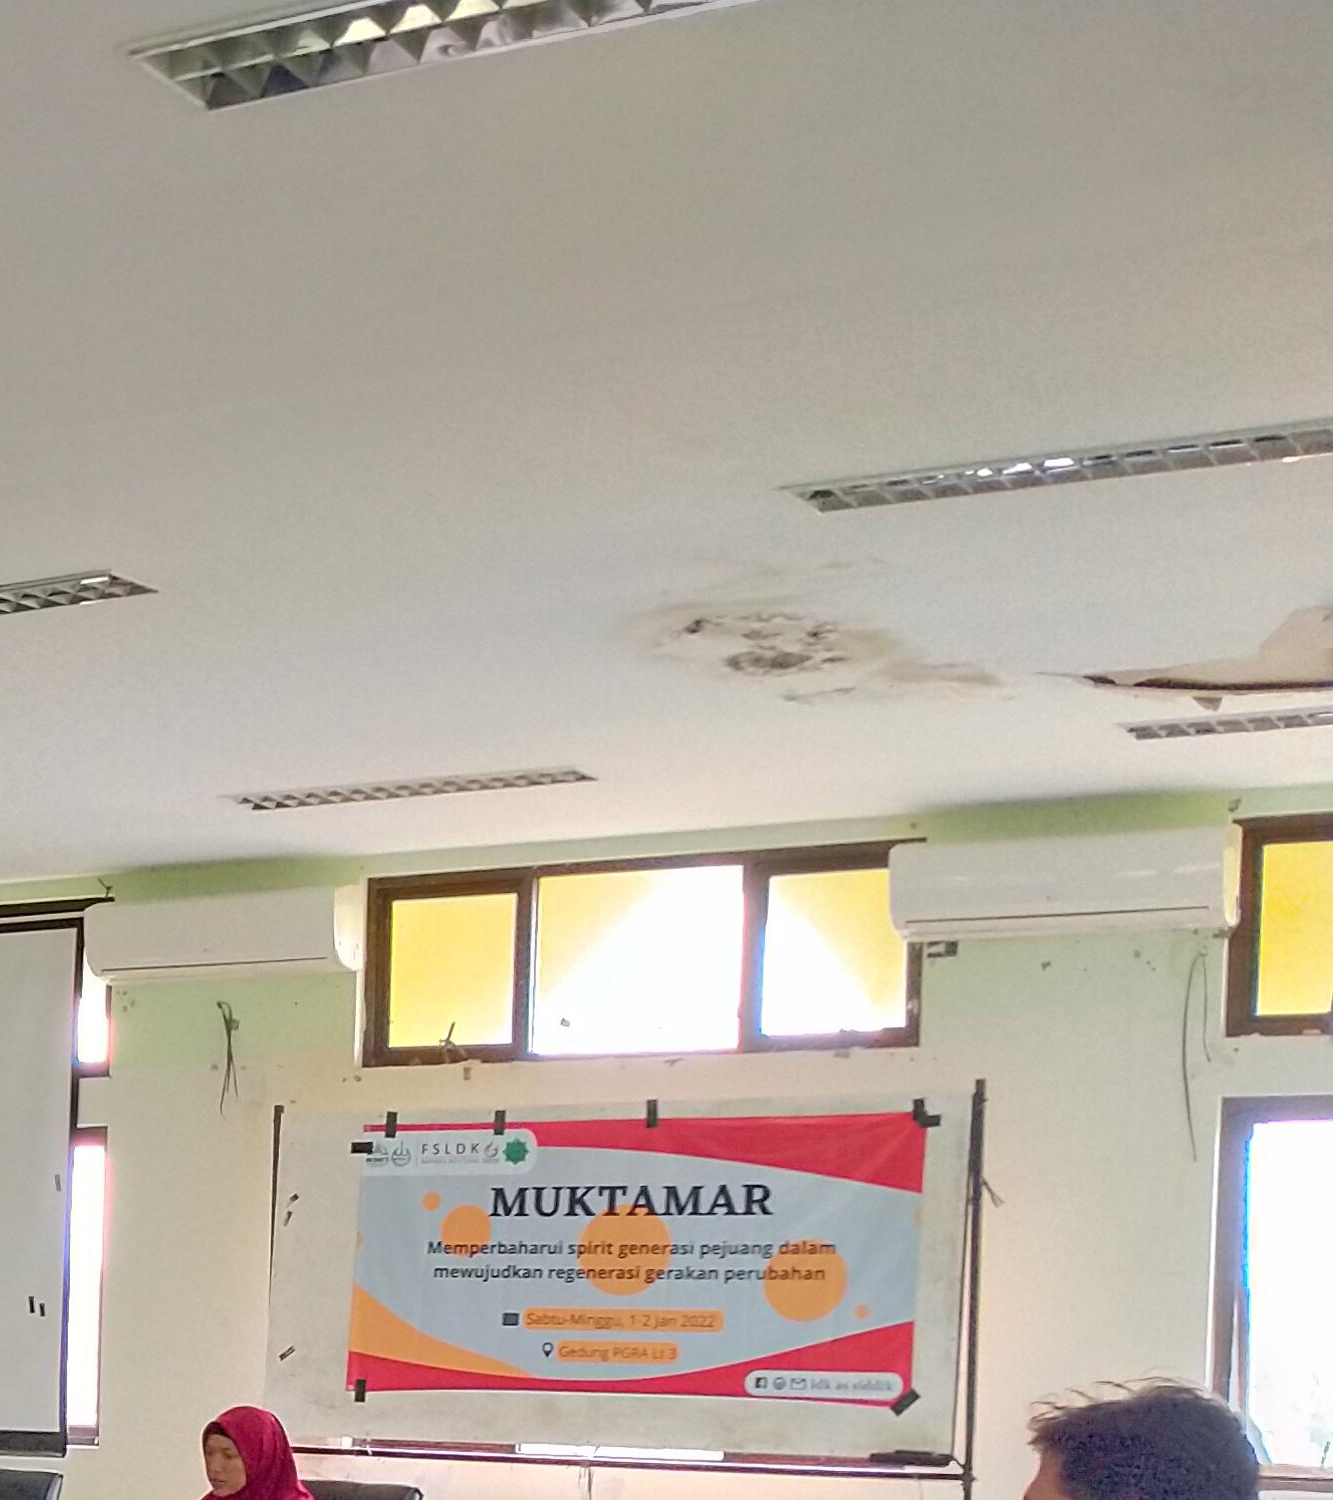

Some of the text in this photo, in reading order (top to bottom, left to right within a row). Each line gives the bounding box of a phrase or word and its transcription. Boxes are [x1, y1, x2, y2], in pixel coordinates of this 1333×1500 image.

[489, 1184, 774, 1218] MUKTAMAR
[427, 1240, 837, 1259] Memperbaharui spirit generasi pejuang dalam
[433, 1265, 826, 1283] mewujudkan regenerasi gerakan perubahan
[558, 1345, 609, 1361] Gedung
